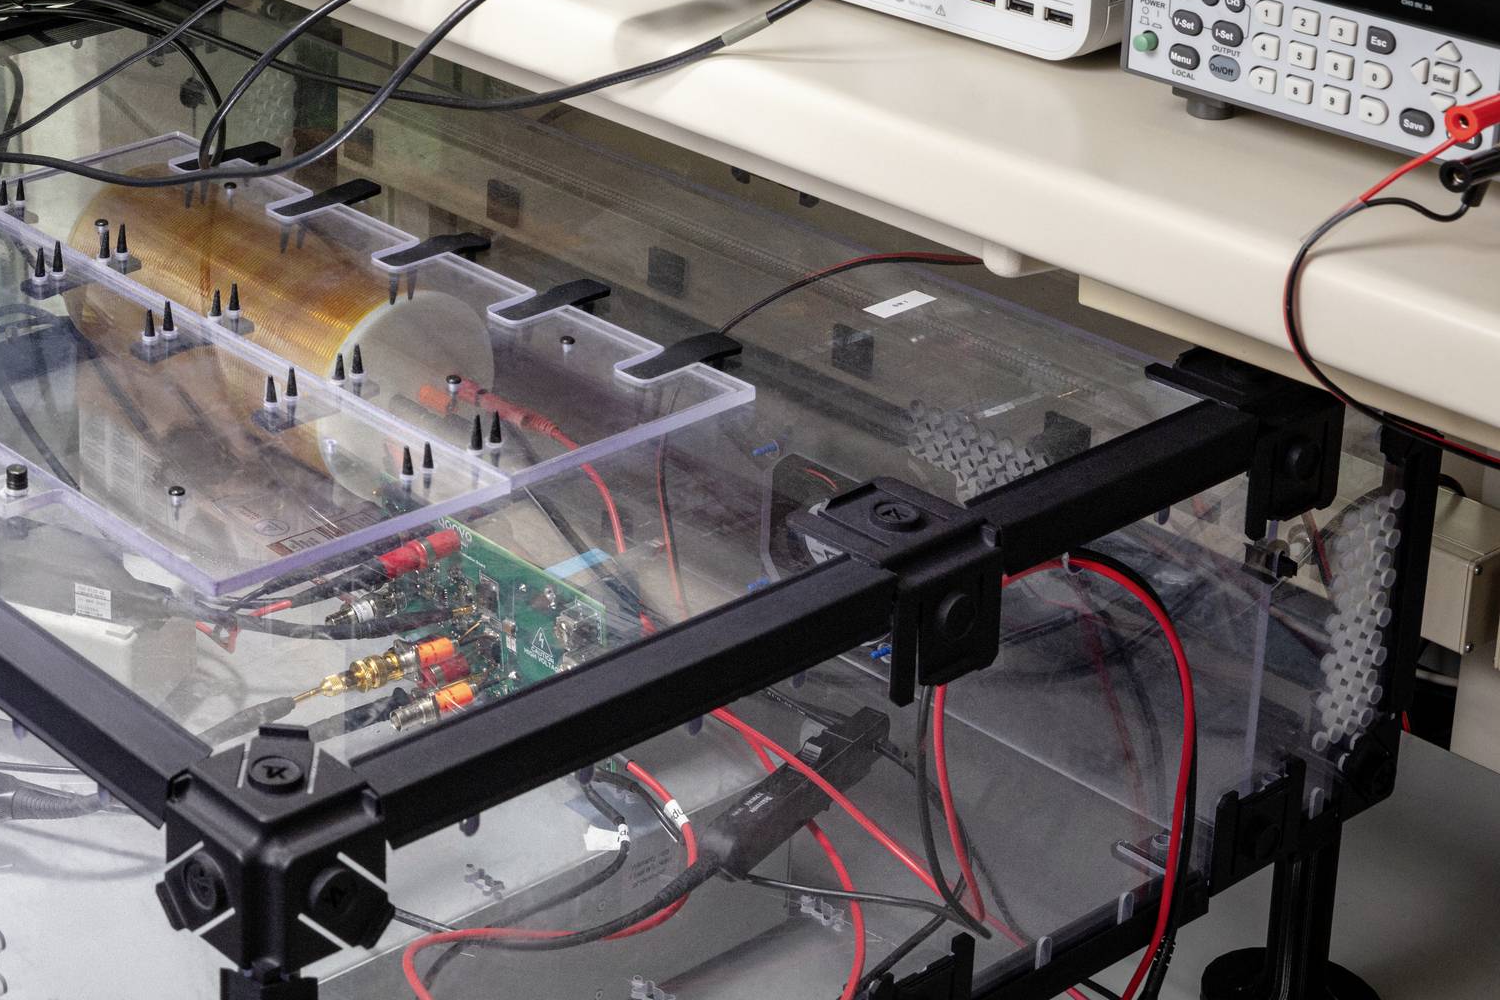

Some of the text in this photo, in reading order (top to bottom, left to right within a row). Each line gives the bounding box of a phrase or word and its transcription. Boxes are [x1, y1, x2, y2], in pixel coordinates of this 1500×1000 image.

[1174, 17, 1194, 30] V-Set
[1300, 18, 1306, 27] 2
[1216, 29, 1233, 40] I-Set
[1338, 28, 1344, 36] 3
[1370, 36, 1387, 48] Esc
[1212, 44, 1241, 58] OUTPUT
[1297, 52, 1302, 60] 5
[1171, 51, 1192, 65] Menu
[1210, 63, 1234, 76] On/Off
[1333, 62, 1339, 71] 6
[1172, 68, 1195, 80] LOCAL
[1258, 77, 1264, 85] 7
[1432, 74, 1452, 86] Enter
[1293, 87, 1298, 95] 8
[1329, 97, 1335, 106] 9
[1404, 119, 1425, 132] Save
